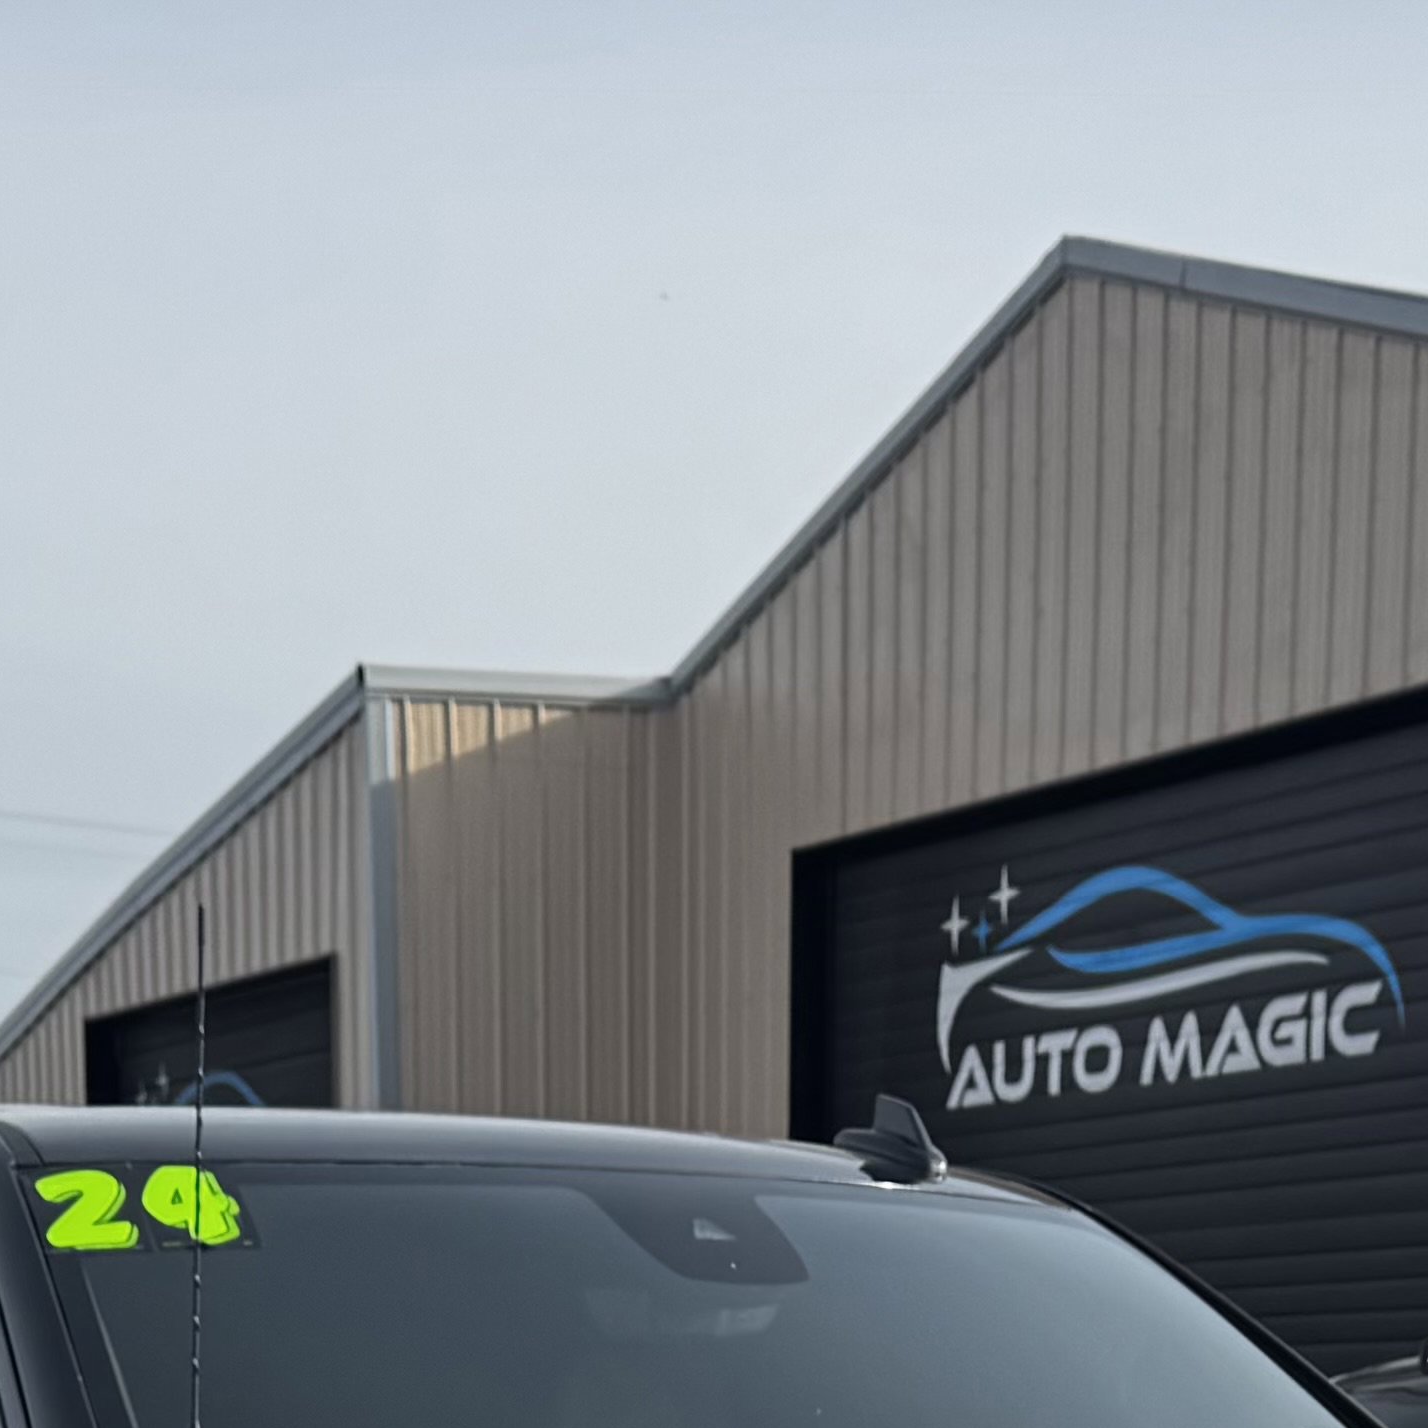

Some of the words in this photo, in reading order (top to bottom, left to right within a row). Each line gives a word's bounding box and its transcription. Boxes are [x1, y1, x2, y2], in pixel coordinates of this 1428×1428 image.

[946, 1023, 1123, 1110] AUTO
[1139, 980, 1383, 1087] MAGIC
[34, 1165, 241, 1249] 24
